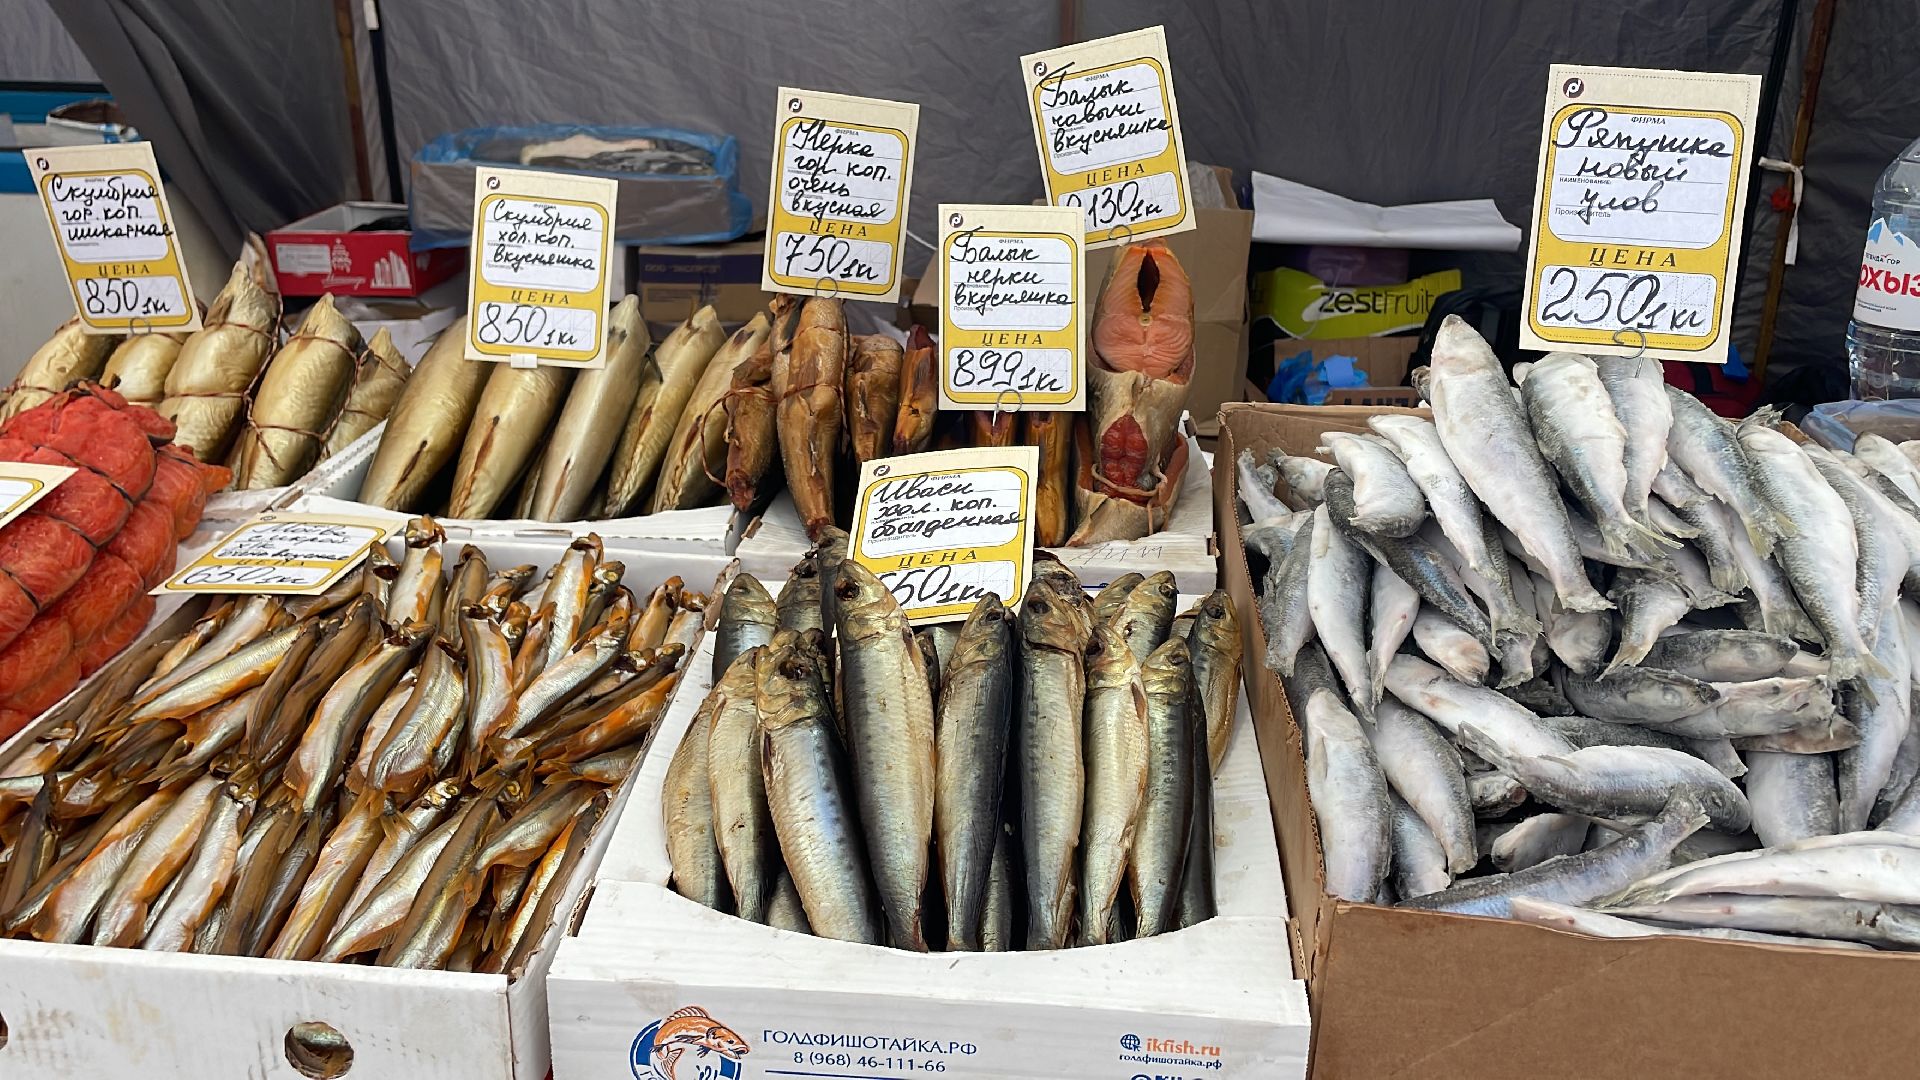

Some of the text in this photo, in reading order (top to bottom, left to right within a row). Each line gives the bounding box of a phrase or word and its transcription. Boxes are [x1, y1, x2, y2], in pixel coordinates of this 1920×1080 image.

[1039, 62, 1134, 107] Балык
[1052, 100, 1146, 127] чавычи
[1631, 116, 1666, 125] ФИРМА
[792, 119, 875, 161] Нерка
[1054, 118, 1173, 155] вкусняшка
[1552, 108, 1733, 165] Ряпушка
[847, 162, 892, 182] коп.
[1086, 163, 1145, 186] ЦЕНА
[1576, 154, 1688, 181] новый
[51, 174, 159, 206] Скумбрия
[788, 176, 850, 197] очень
[62, 206, 142, 221] гор. коп.
[493, 199, 593, 234] Скумбрия
[792, 190, 886, 220] вкусная
[1580, 181, 1664, 225] улов
[68, 223, 174, 240] шикарная
[498, 231, 575, 249] хол. коп.
[809, 220, 868, 236] ЦЕНА
[493, 244, 596, 273] вкусняшка
[785, 234, 850, 276] 750
[950, 226, 1040, 264] Балык
[1589, 247, 1677, 267] ЦЕНА
[98, 264, 150, 277] ЦЕНА
[967, 268, 1045, 294] нерки
[85, 278, 139, 314] 850
[511, 290, 570, 305] ЦЕНА
[954, 282, 1075, 315] вкусняшка
[1542, 267, 1660, 325] 250
[479, 302, 547, 344] 850
[981, 333, 1043, 346] ЦЕНА
[953, 349, 1023, 386] 899
[874, 474, 973, 503] Иваси
[950, 498, 997, 511] коп.
[871, 512, 1026, 539] обалденная
[898, 550, 977, 569] ЦЕНА
[184, 565, 276, 585] 650
[880, 565, 951, 606] 50
[762, 1029, 978, 1056] ГОЛДФИШОТАЙКА.РФ
[1146, 1038, 1220, 1057] ikfish.ru
[794, 1052, 946, 1073] 8 (968) 46-111-66
[1119, 1054, 1222, 1070] голдфишотайка.рф
